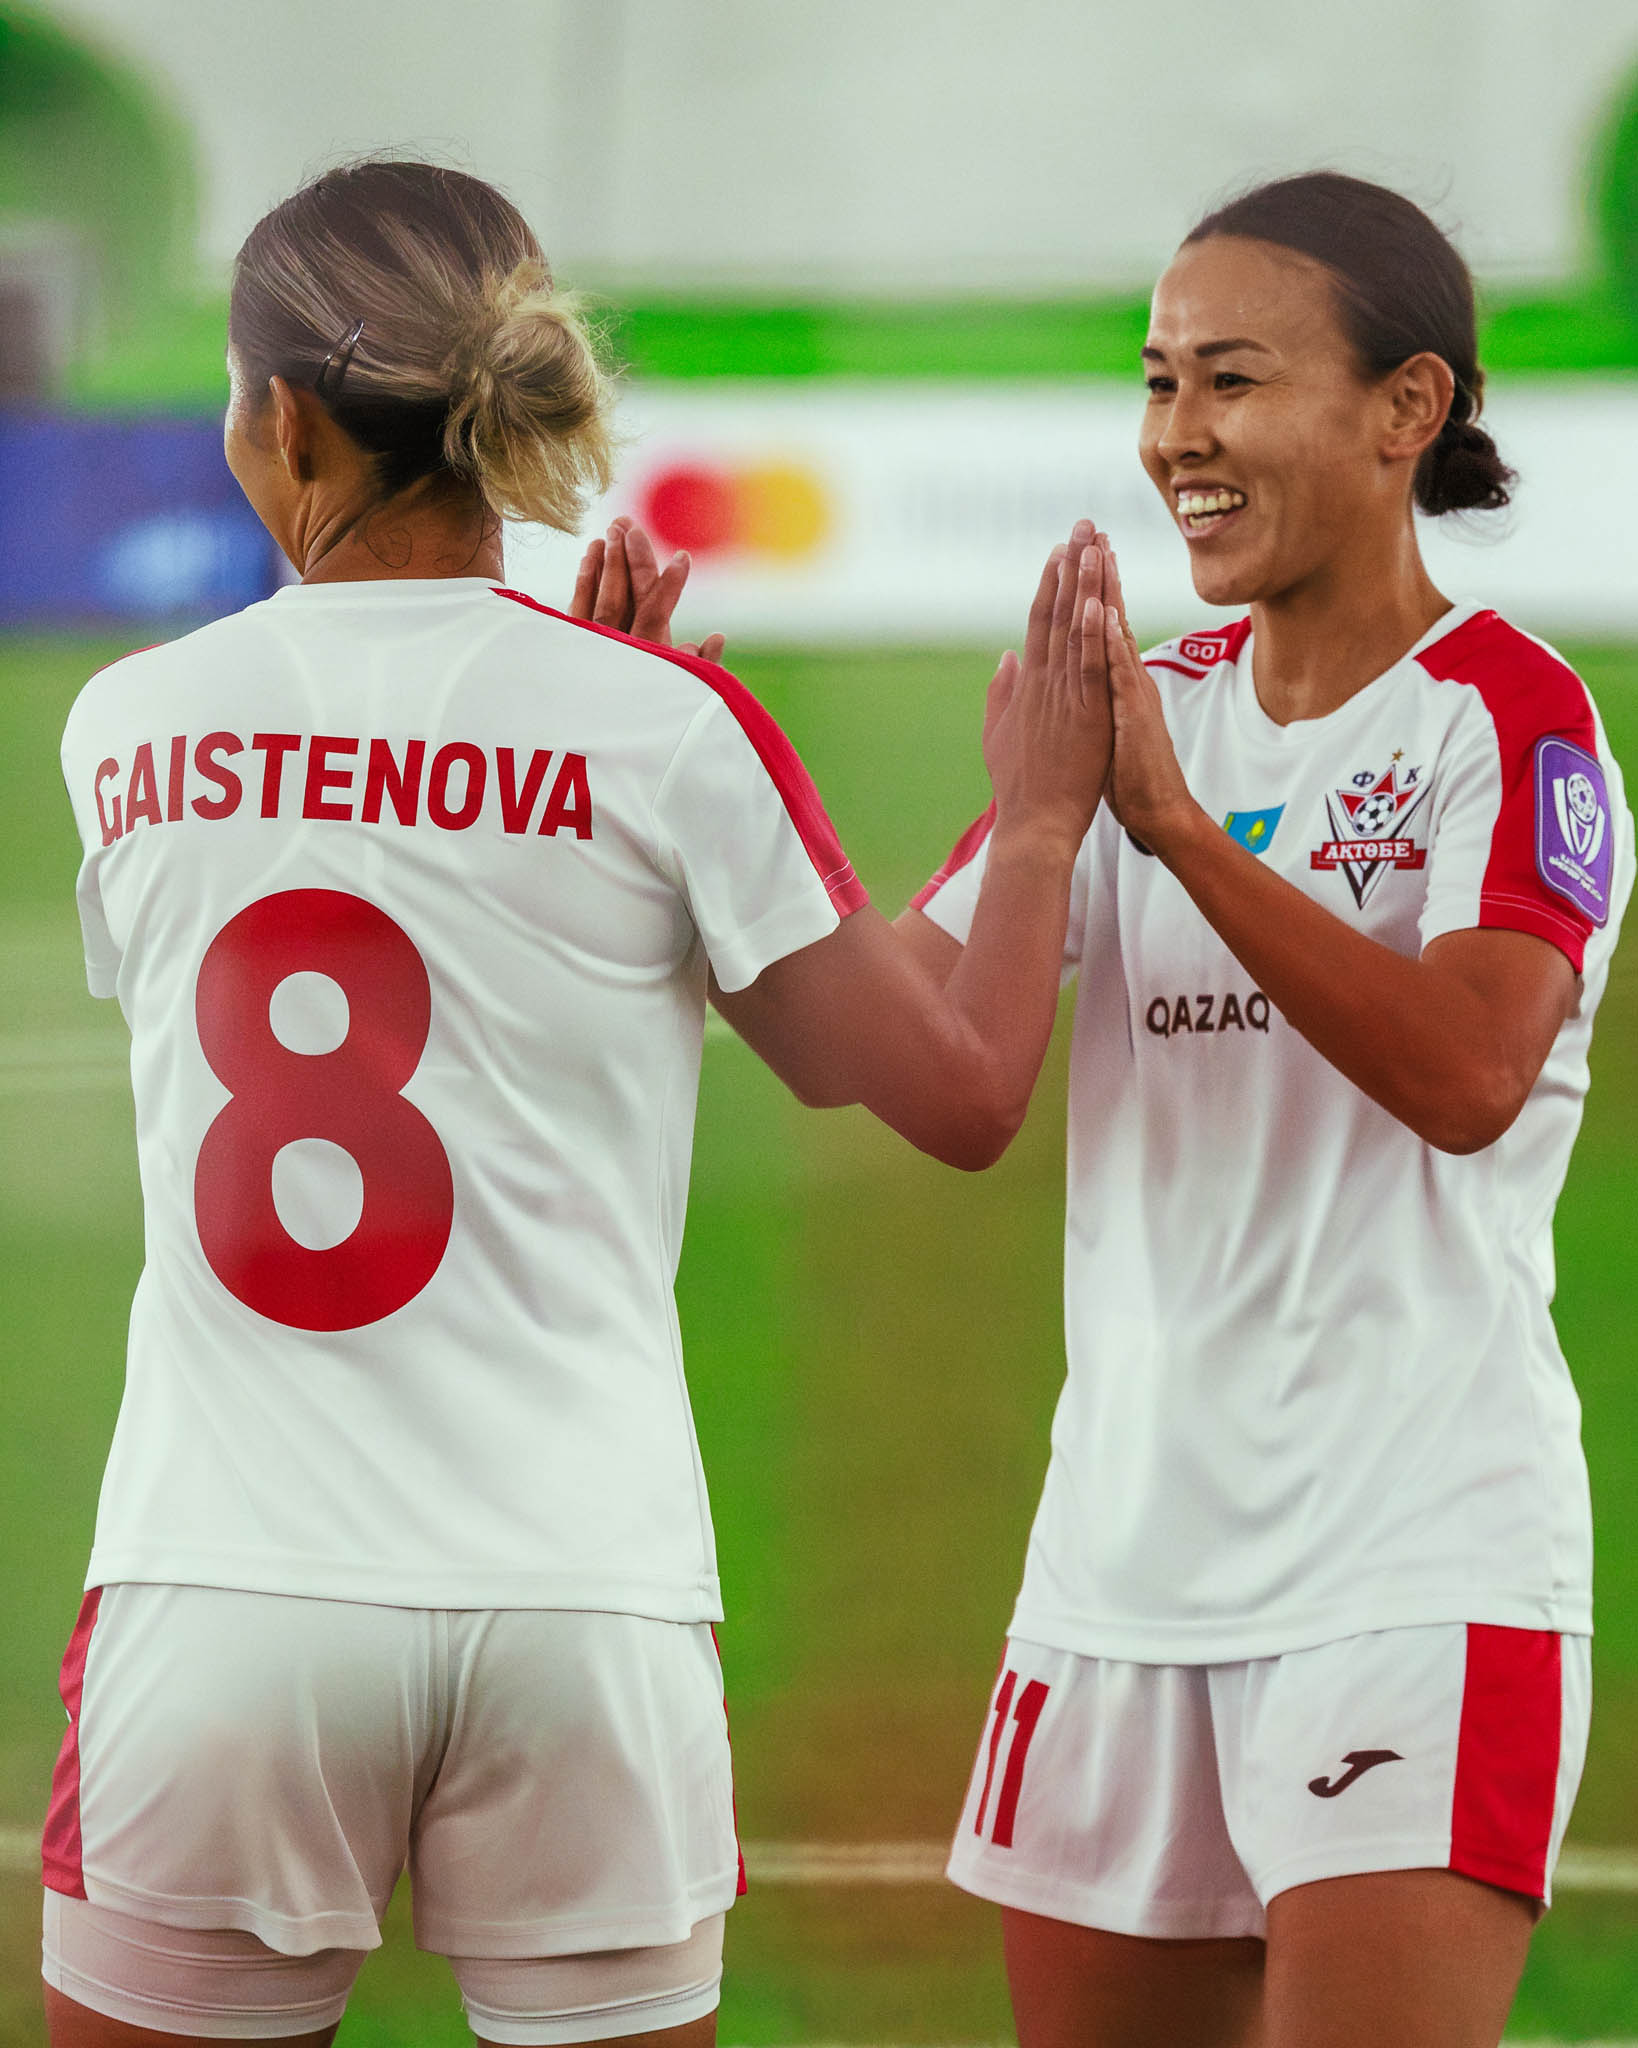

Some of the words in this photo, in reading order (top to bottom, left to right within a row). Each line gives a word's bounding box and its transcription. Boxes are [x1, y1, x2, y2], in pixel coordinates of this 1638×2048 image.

[1184, 643, 1216, 660] GO
[95, 731, 593, 847] GAISTENOVA
[1146, 991, 1270, 1039] QAZAQ
[194, 888, 454, 1332] 8
[974, 1669, 1050, 1848] 11
